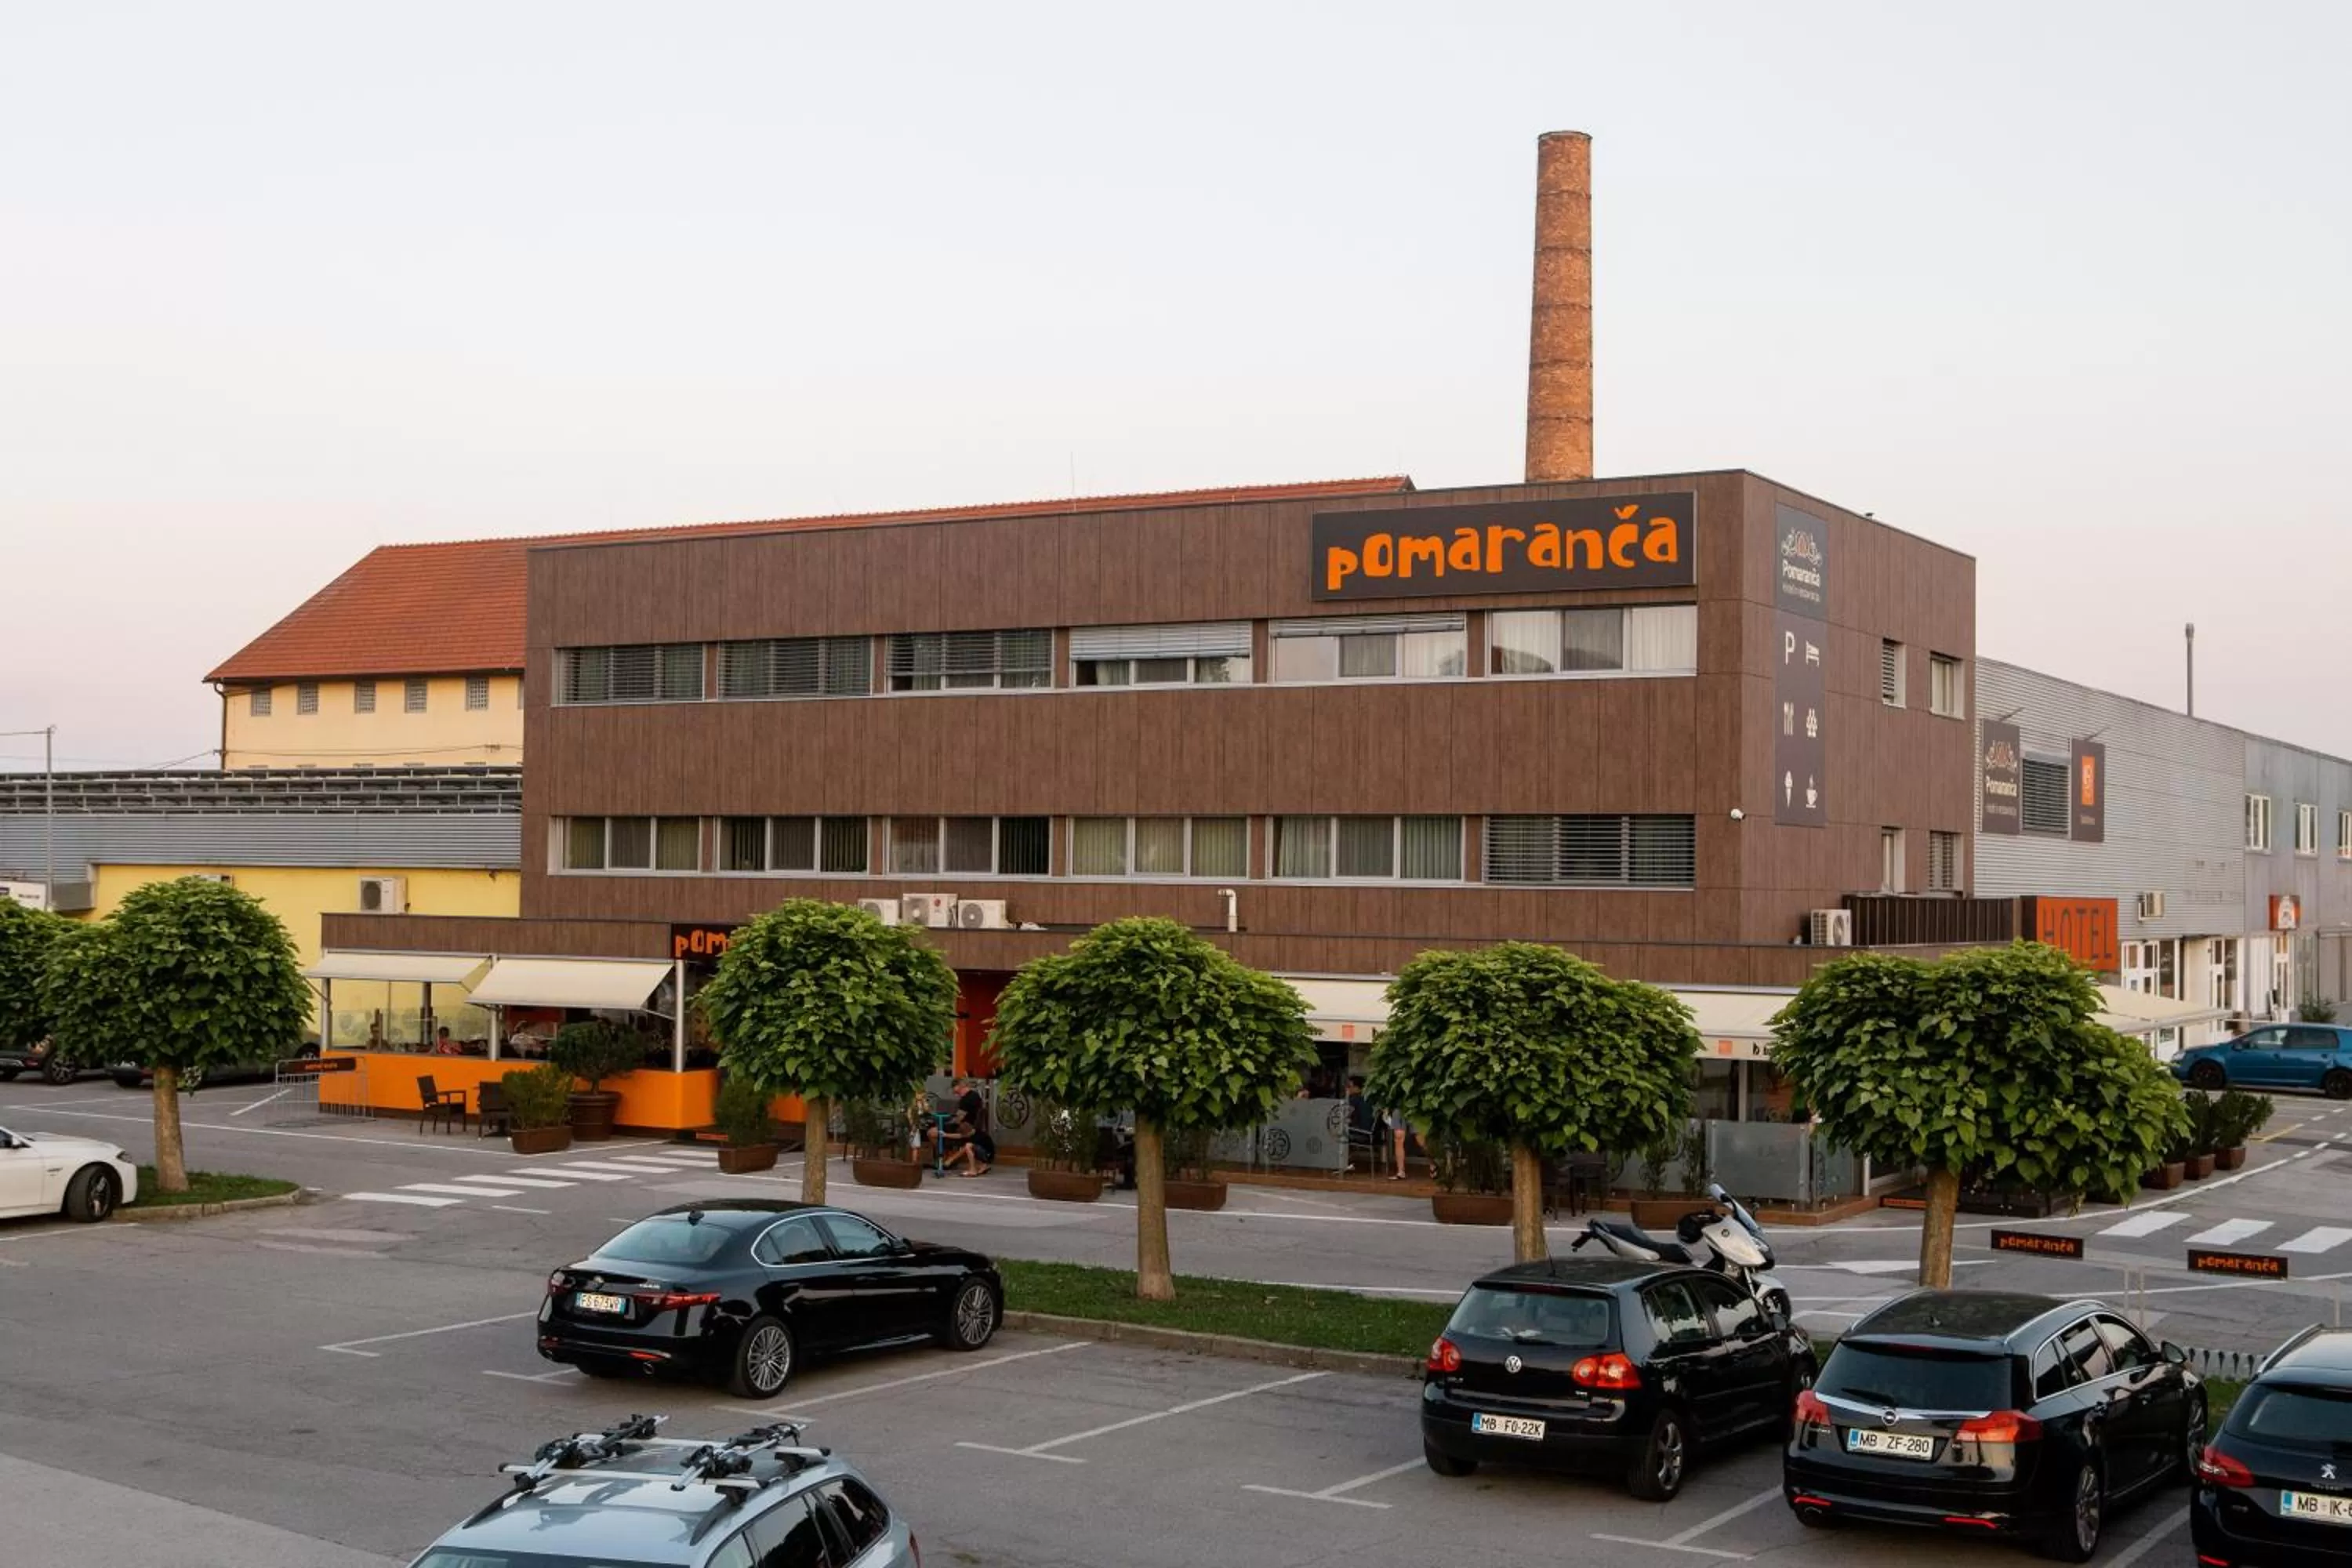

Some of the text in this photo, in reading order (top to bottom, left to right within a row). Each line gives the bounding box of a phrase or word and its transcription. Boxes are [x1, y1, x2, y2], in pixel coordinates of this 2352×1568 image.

[1327, 503, 1678, 590] pomaranča
[2042, 906, 2112, 960] HOTEL
[1481, 1417, 1497, 1431] MB
[1859, 1432, 1929, 1453] MB ZF-280
[2297, 1496, 2318, 1512] MB
